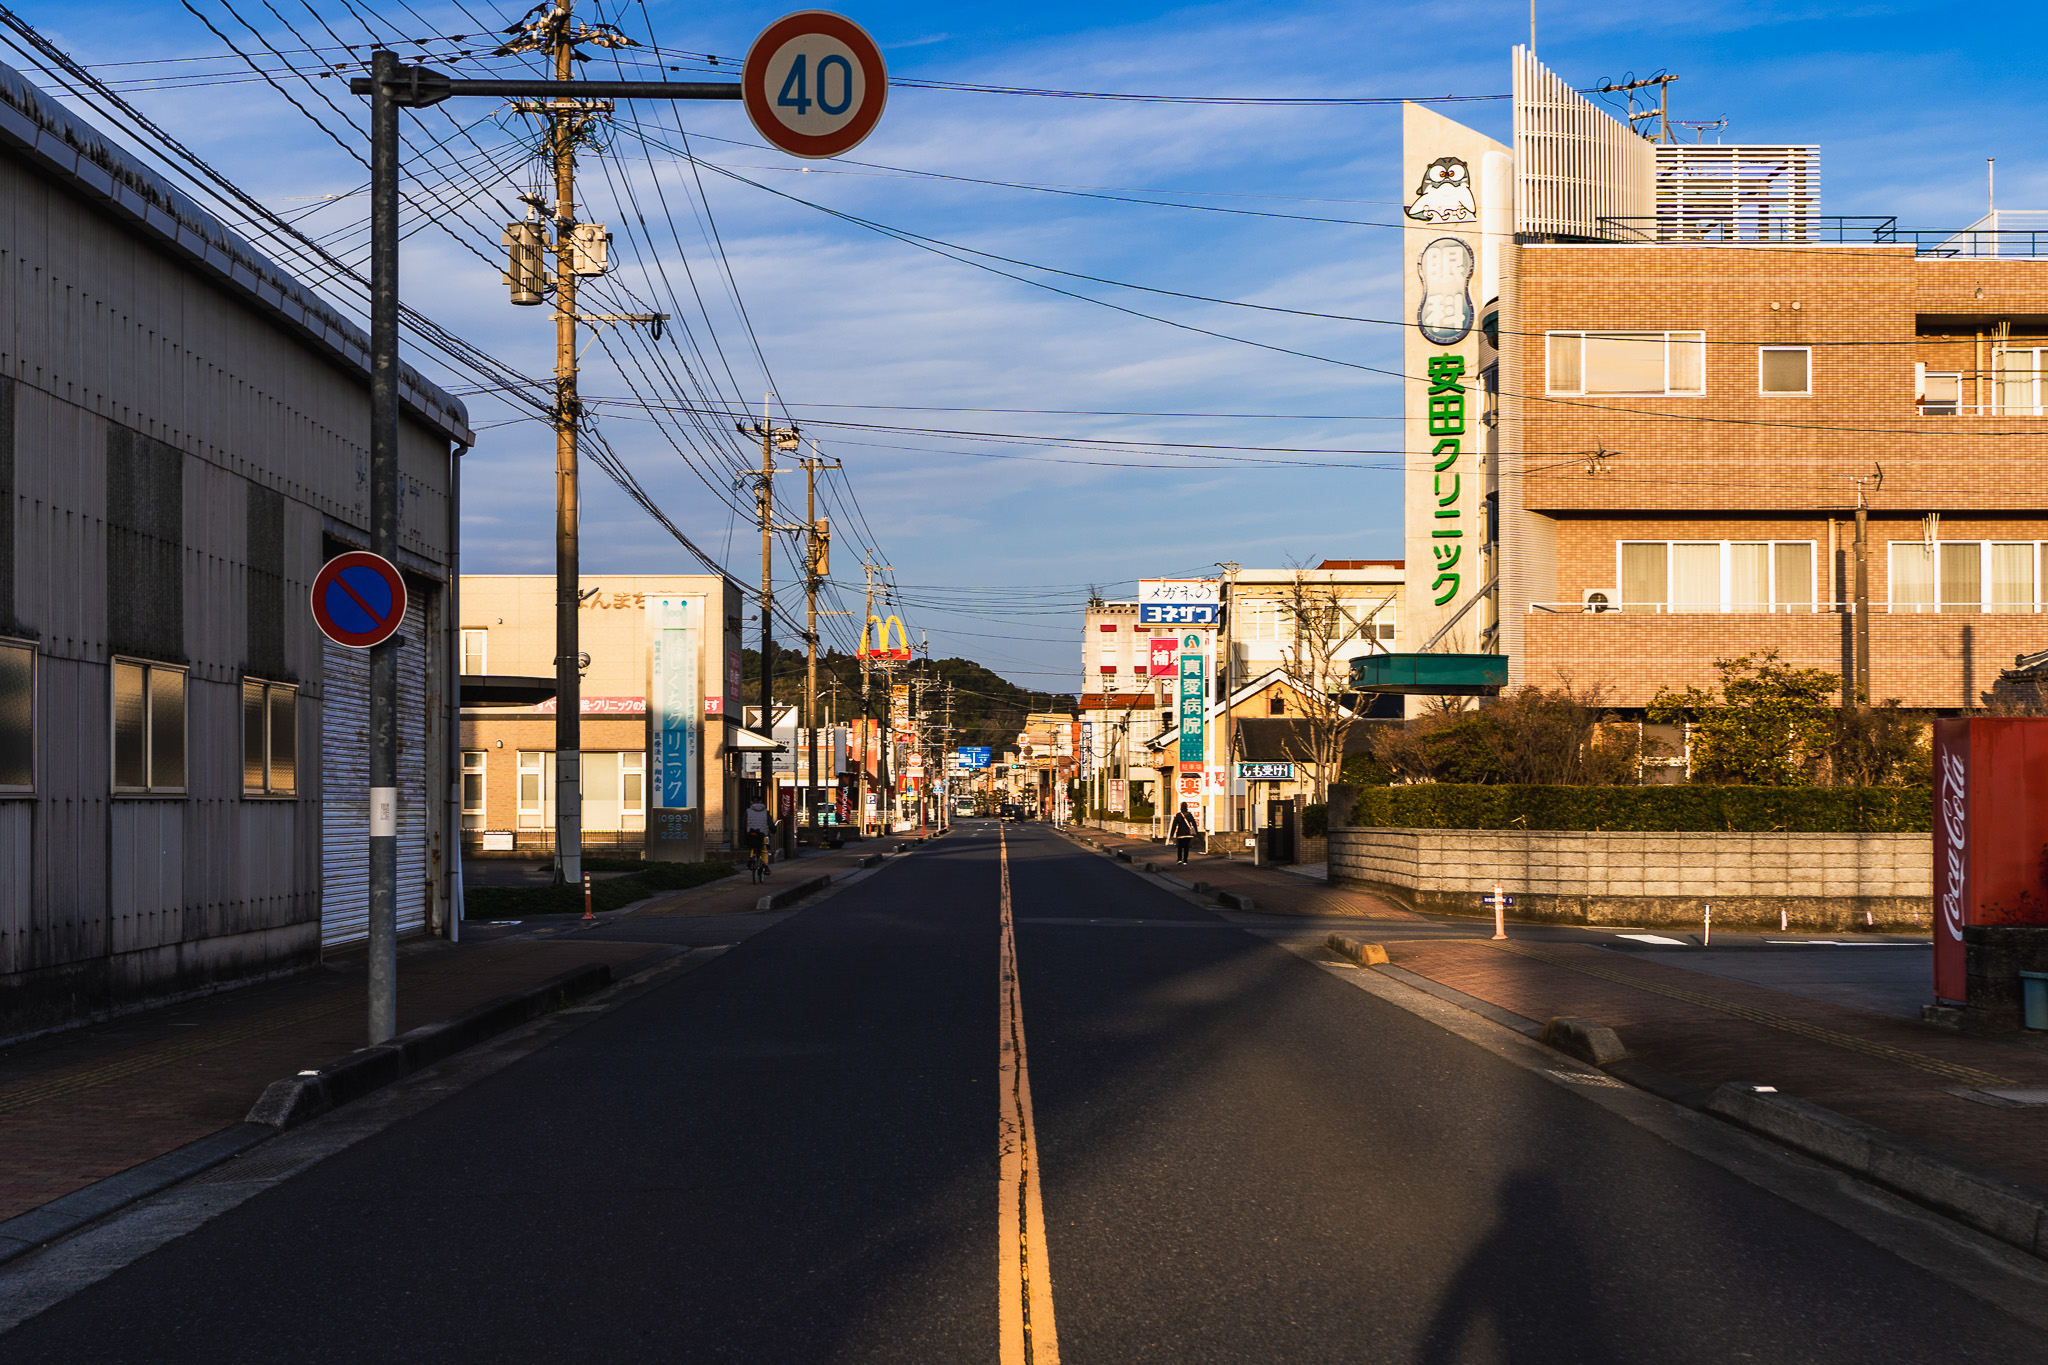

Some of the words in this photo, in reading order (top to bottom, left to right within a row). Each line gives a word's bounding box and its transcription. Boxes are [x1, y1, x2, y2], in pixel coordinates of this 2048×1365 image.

[777, 53, 853, 116] 40
[1426, 245, 1466, 332] 眼科
[1428, 353, 1466, 606] 安田クリニック
[1150, 585, 1212, 601] メガネの
[1146, 605, 1213, 623] ヨネザワ
[1183, 659, 1202, 735] 真愛病院
[654, 732, 662, 763] 医療法人
[657, 814, 692, 823] (0993)
[667, 823, 682, 831] 58
[660, 831, 689, 840] 2222
[1942, 743, 1965, 942] Coca-Cola
